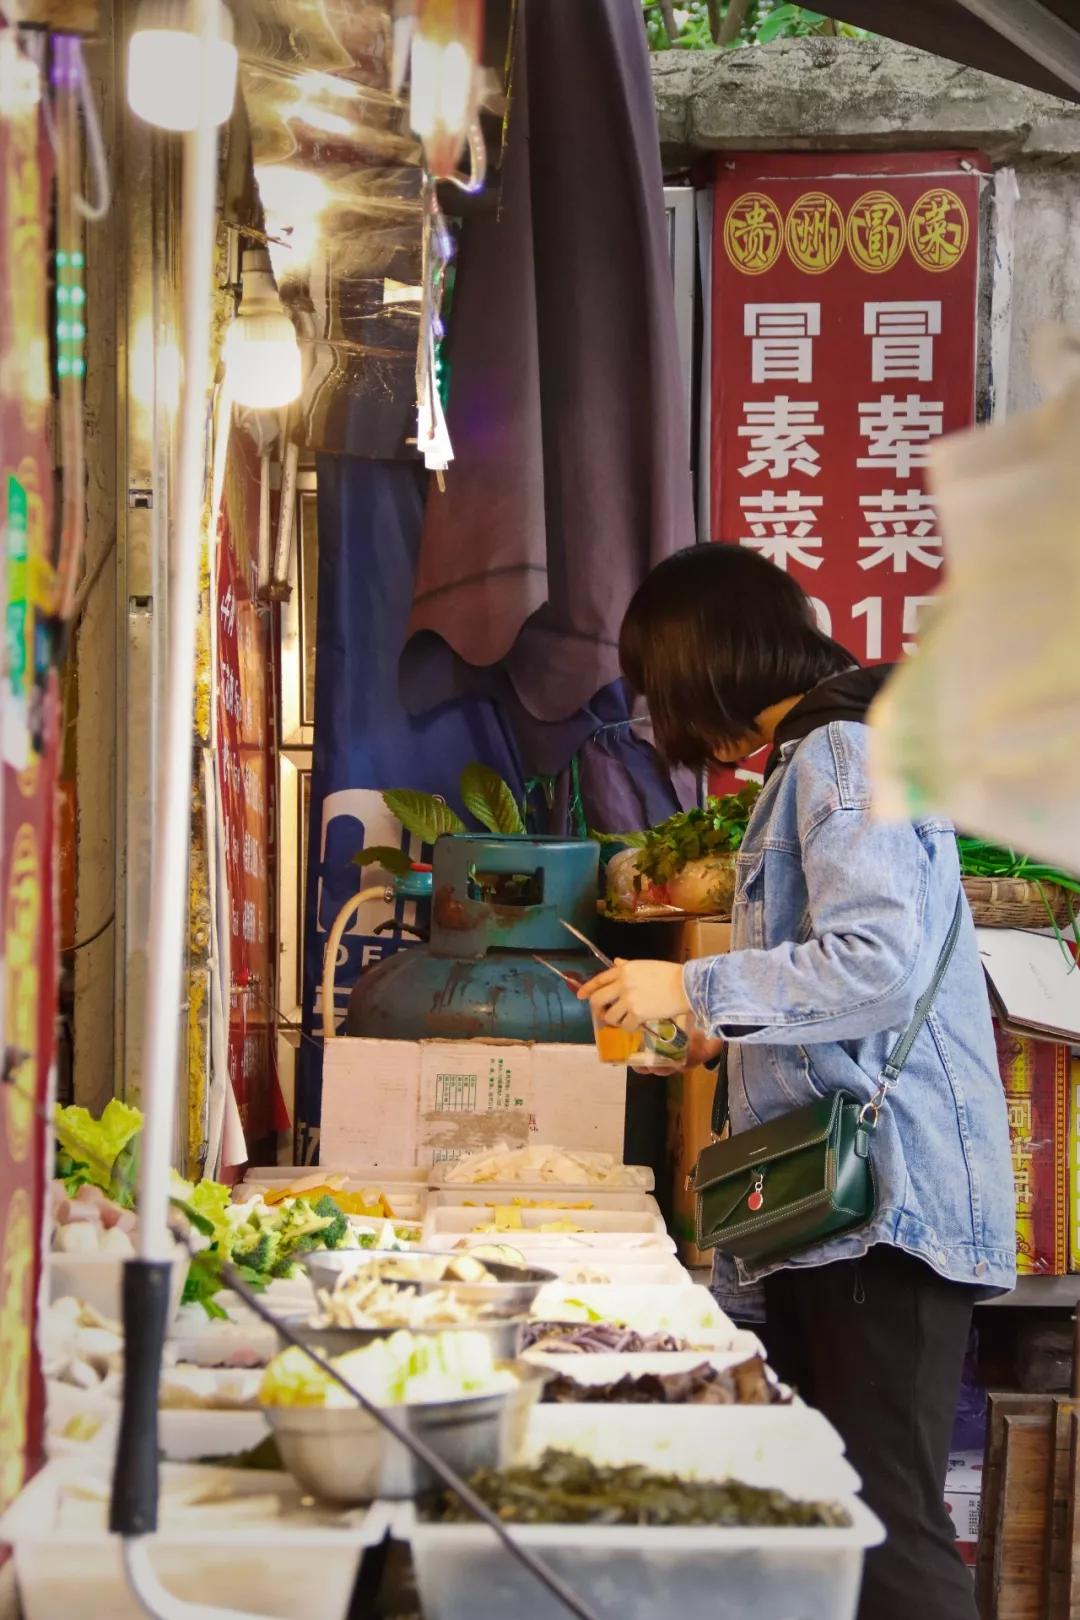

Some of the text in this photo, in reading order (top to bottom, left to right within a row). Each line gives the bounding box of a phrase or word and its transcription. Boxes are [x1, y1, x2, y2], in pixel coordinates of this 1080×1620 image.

[727, 192, 967, 272] 贵州冒菜
[738, 302, 825, 573] 冒素菜
[856, 300, 944, 573] 冒荤菜
